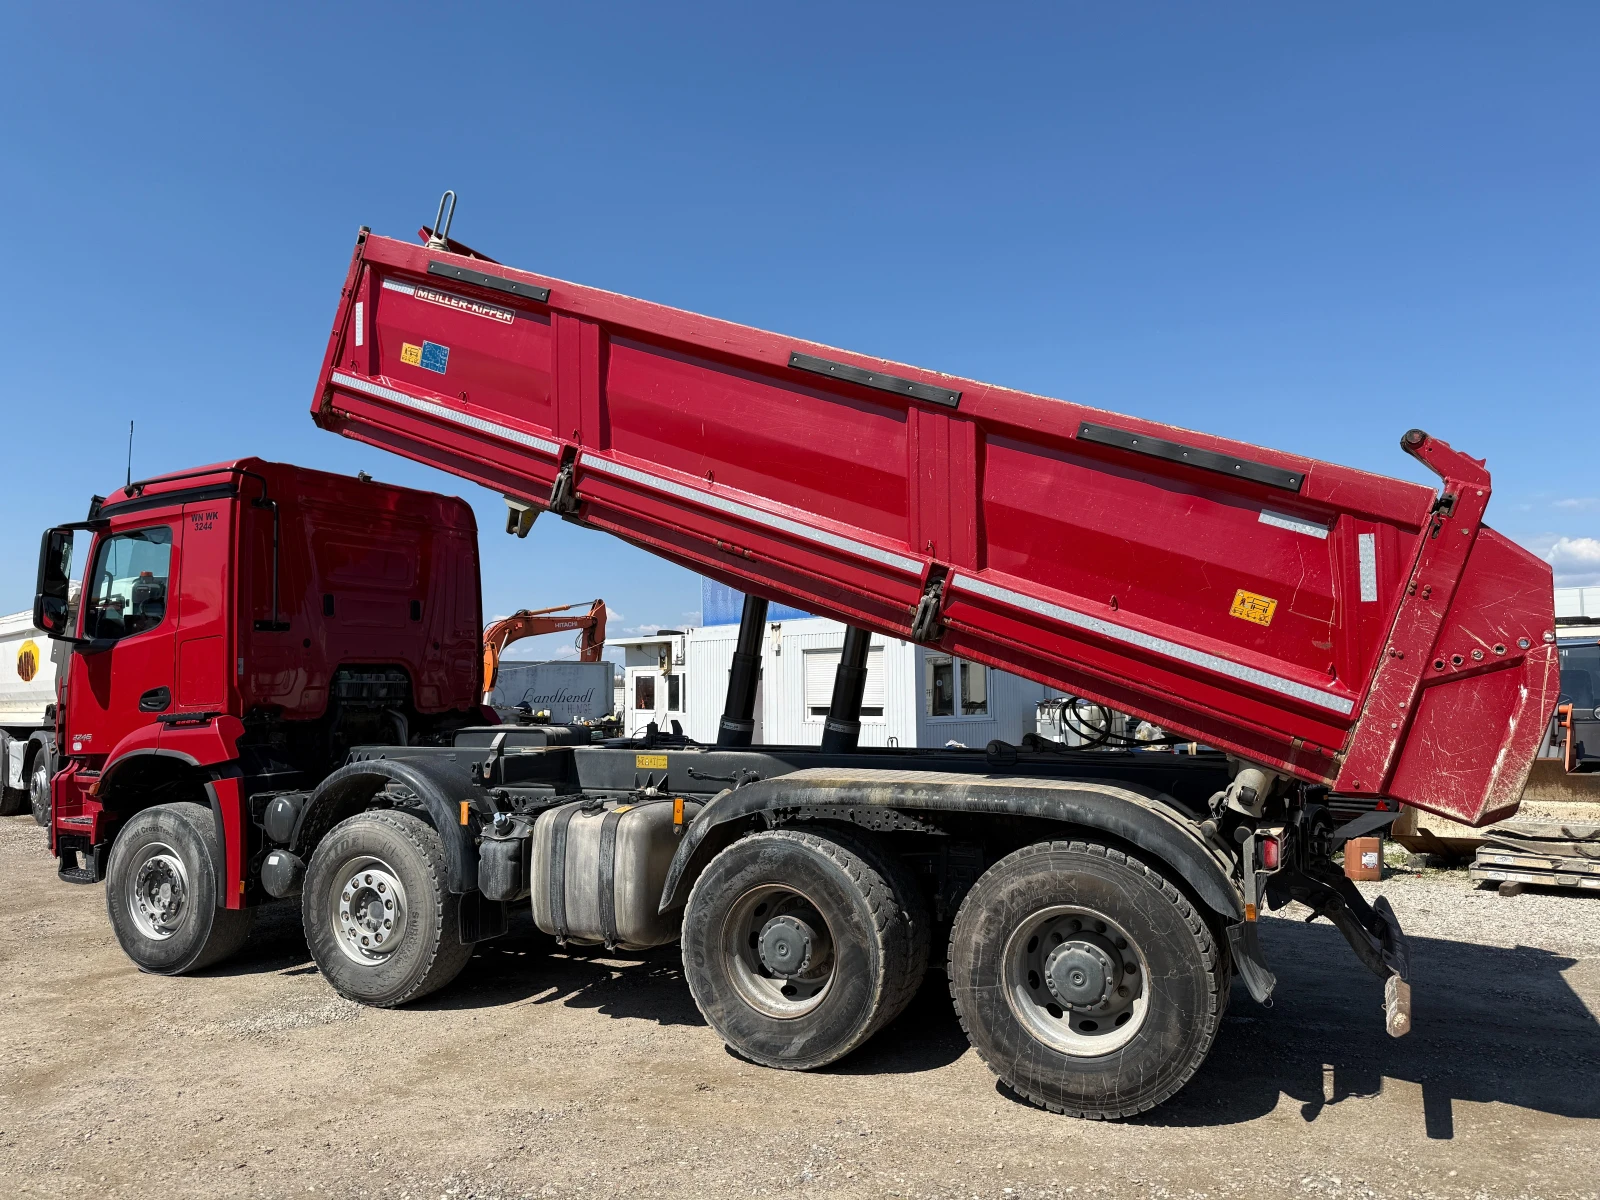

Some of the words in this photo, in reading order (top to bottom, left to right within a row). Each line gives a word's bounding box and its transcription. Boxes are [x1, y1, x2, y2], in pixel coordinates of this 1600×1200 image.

[417, 288, 512, 321] MEILLER-KIPPER
[191, 514, 204, 522] WN
[206, 512, 218, 520] WK
[195, 522, 212, 531] 3244
